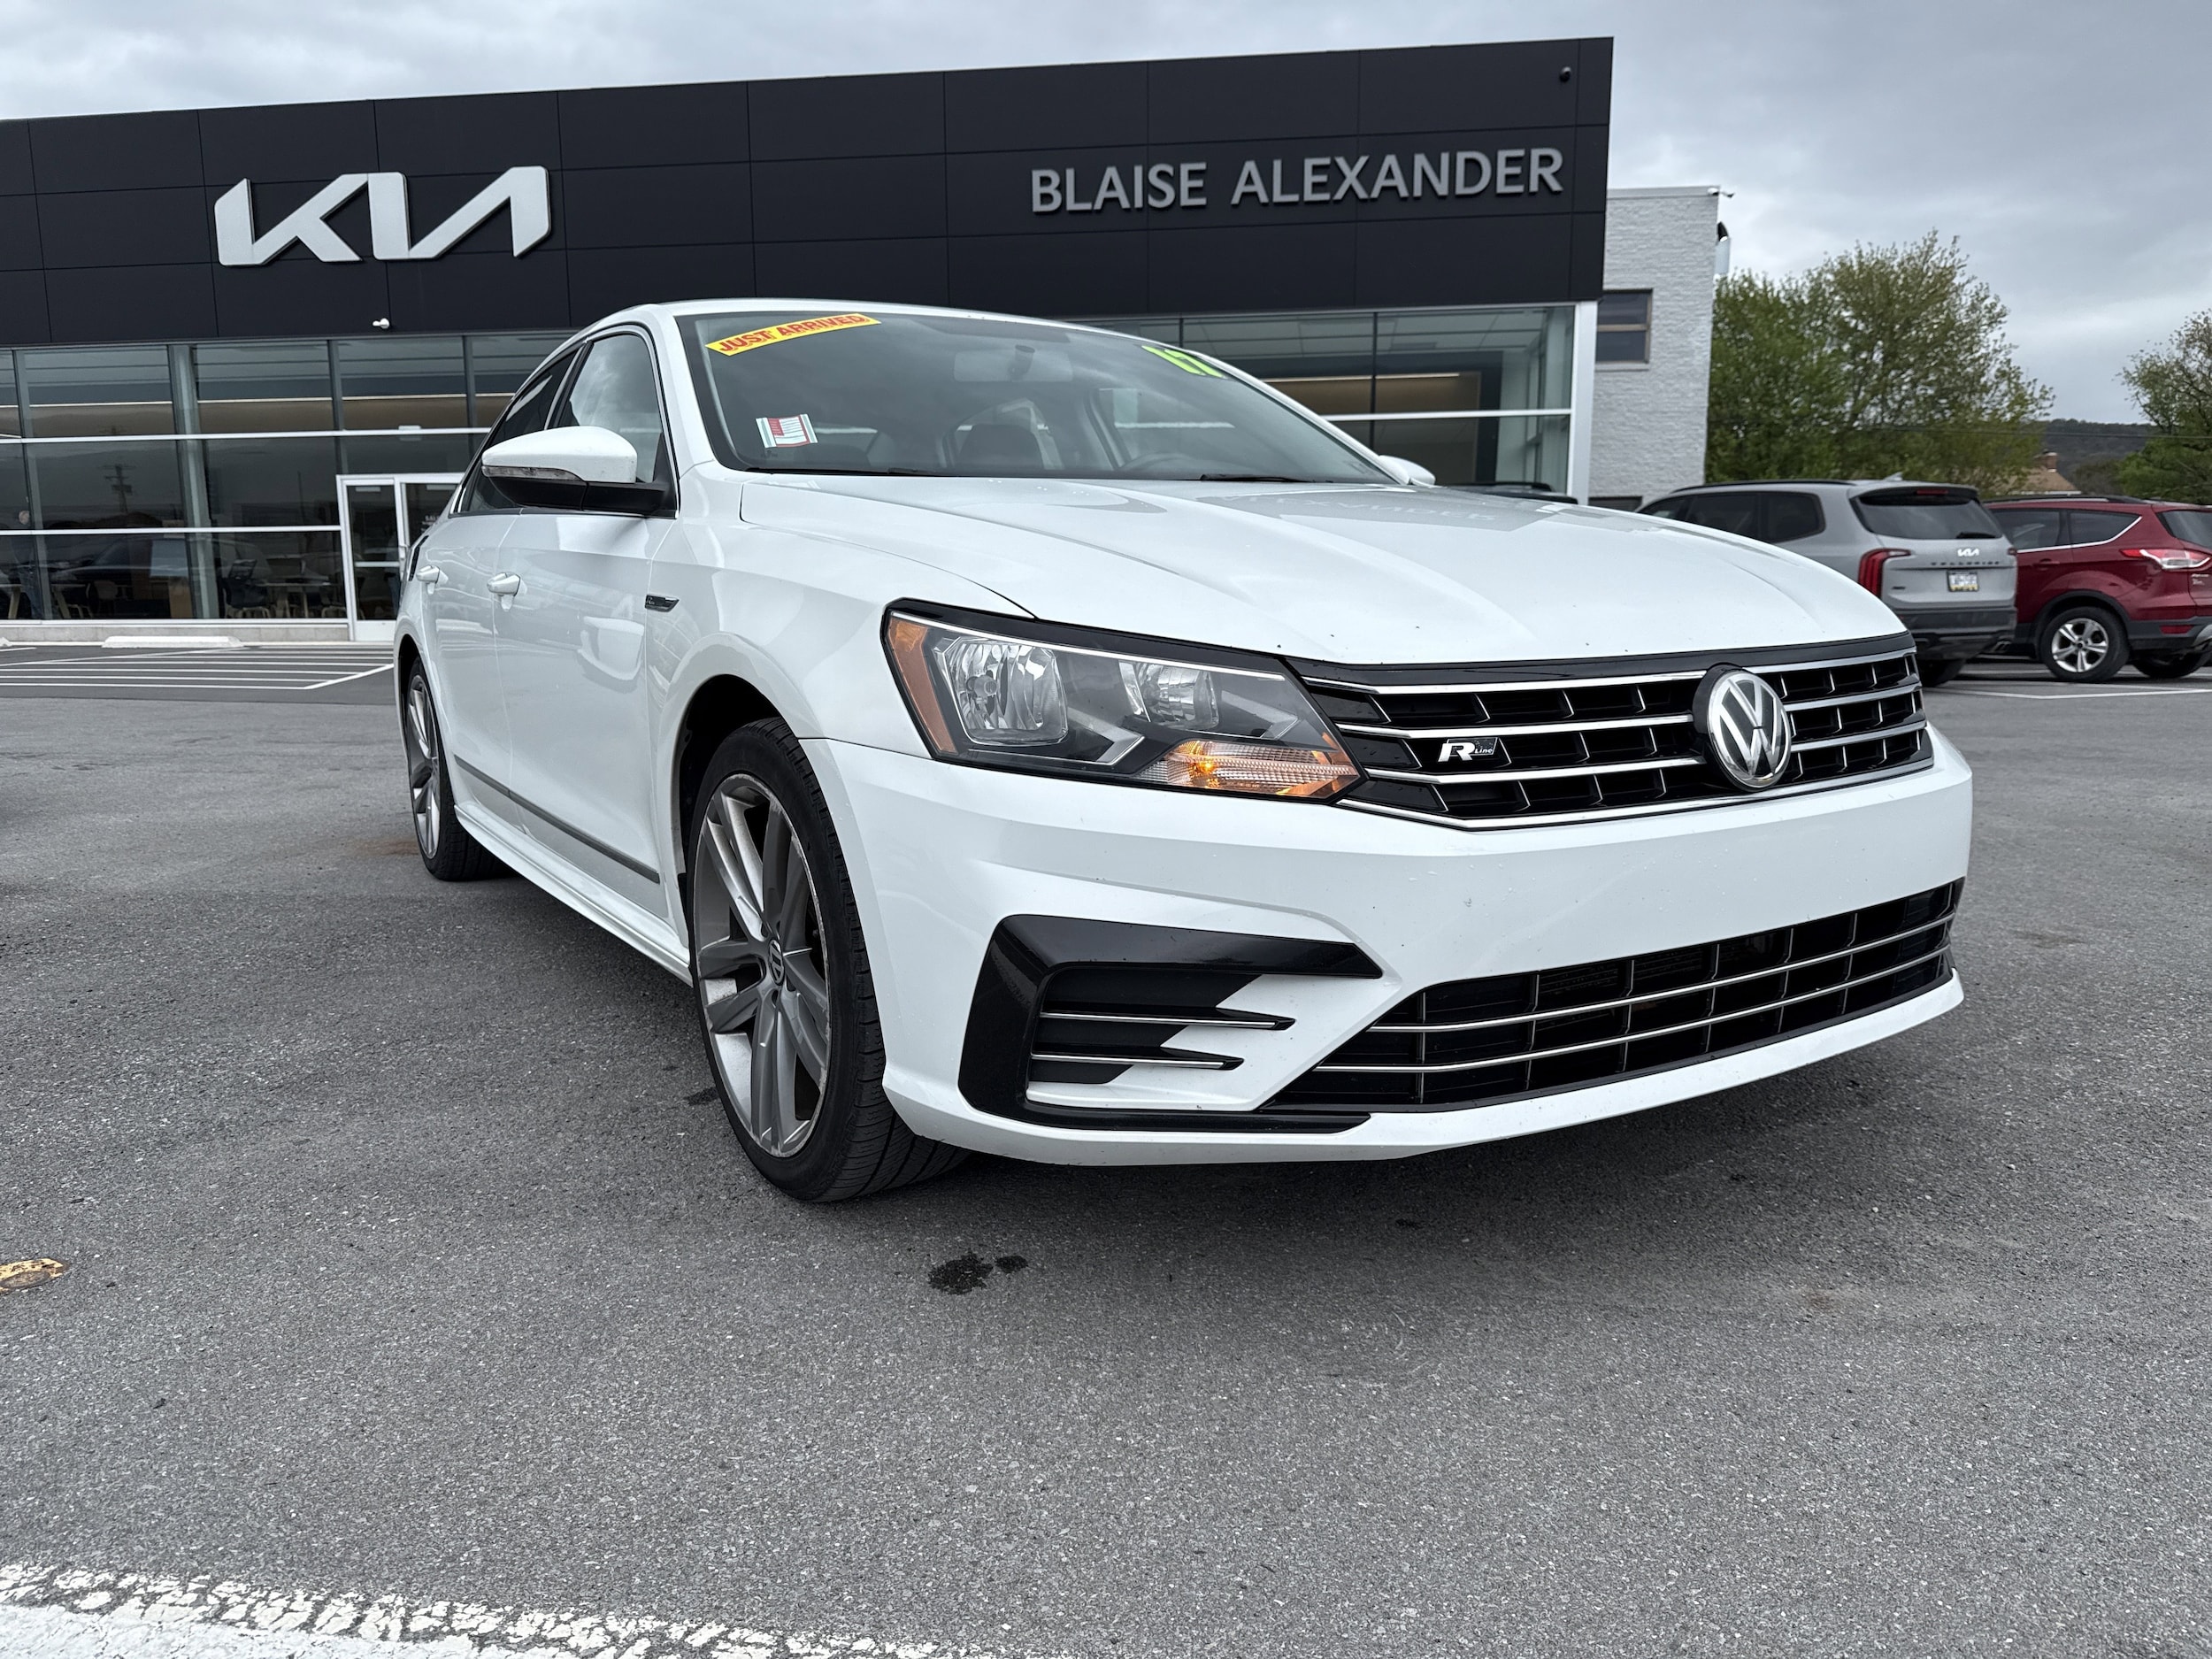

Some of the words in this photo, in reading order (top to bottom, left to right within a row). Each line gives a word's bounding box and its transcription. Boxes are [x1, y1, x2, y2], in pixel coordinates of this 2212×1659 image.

[1031, 162, 1208, 213] BLAISE
[1231, 147, 1564, 205] ALEXANDER
[214, 165, 551, 266] KIA
[719, 330, 773, 352] JUST
[776, 314, 869, 336] ARRIVED
[1438, 741, 1475, 762] R
